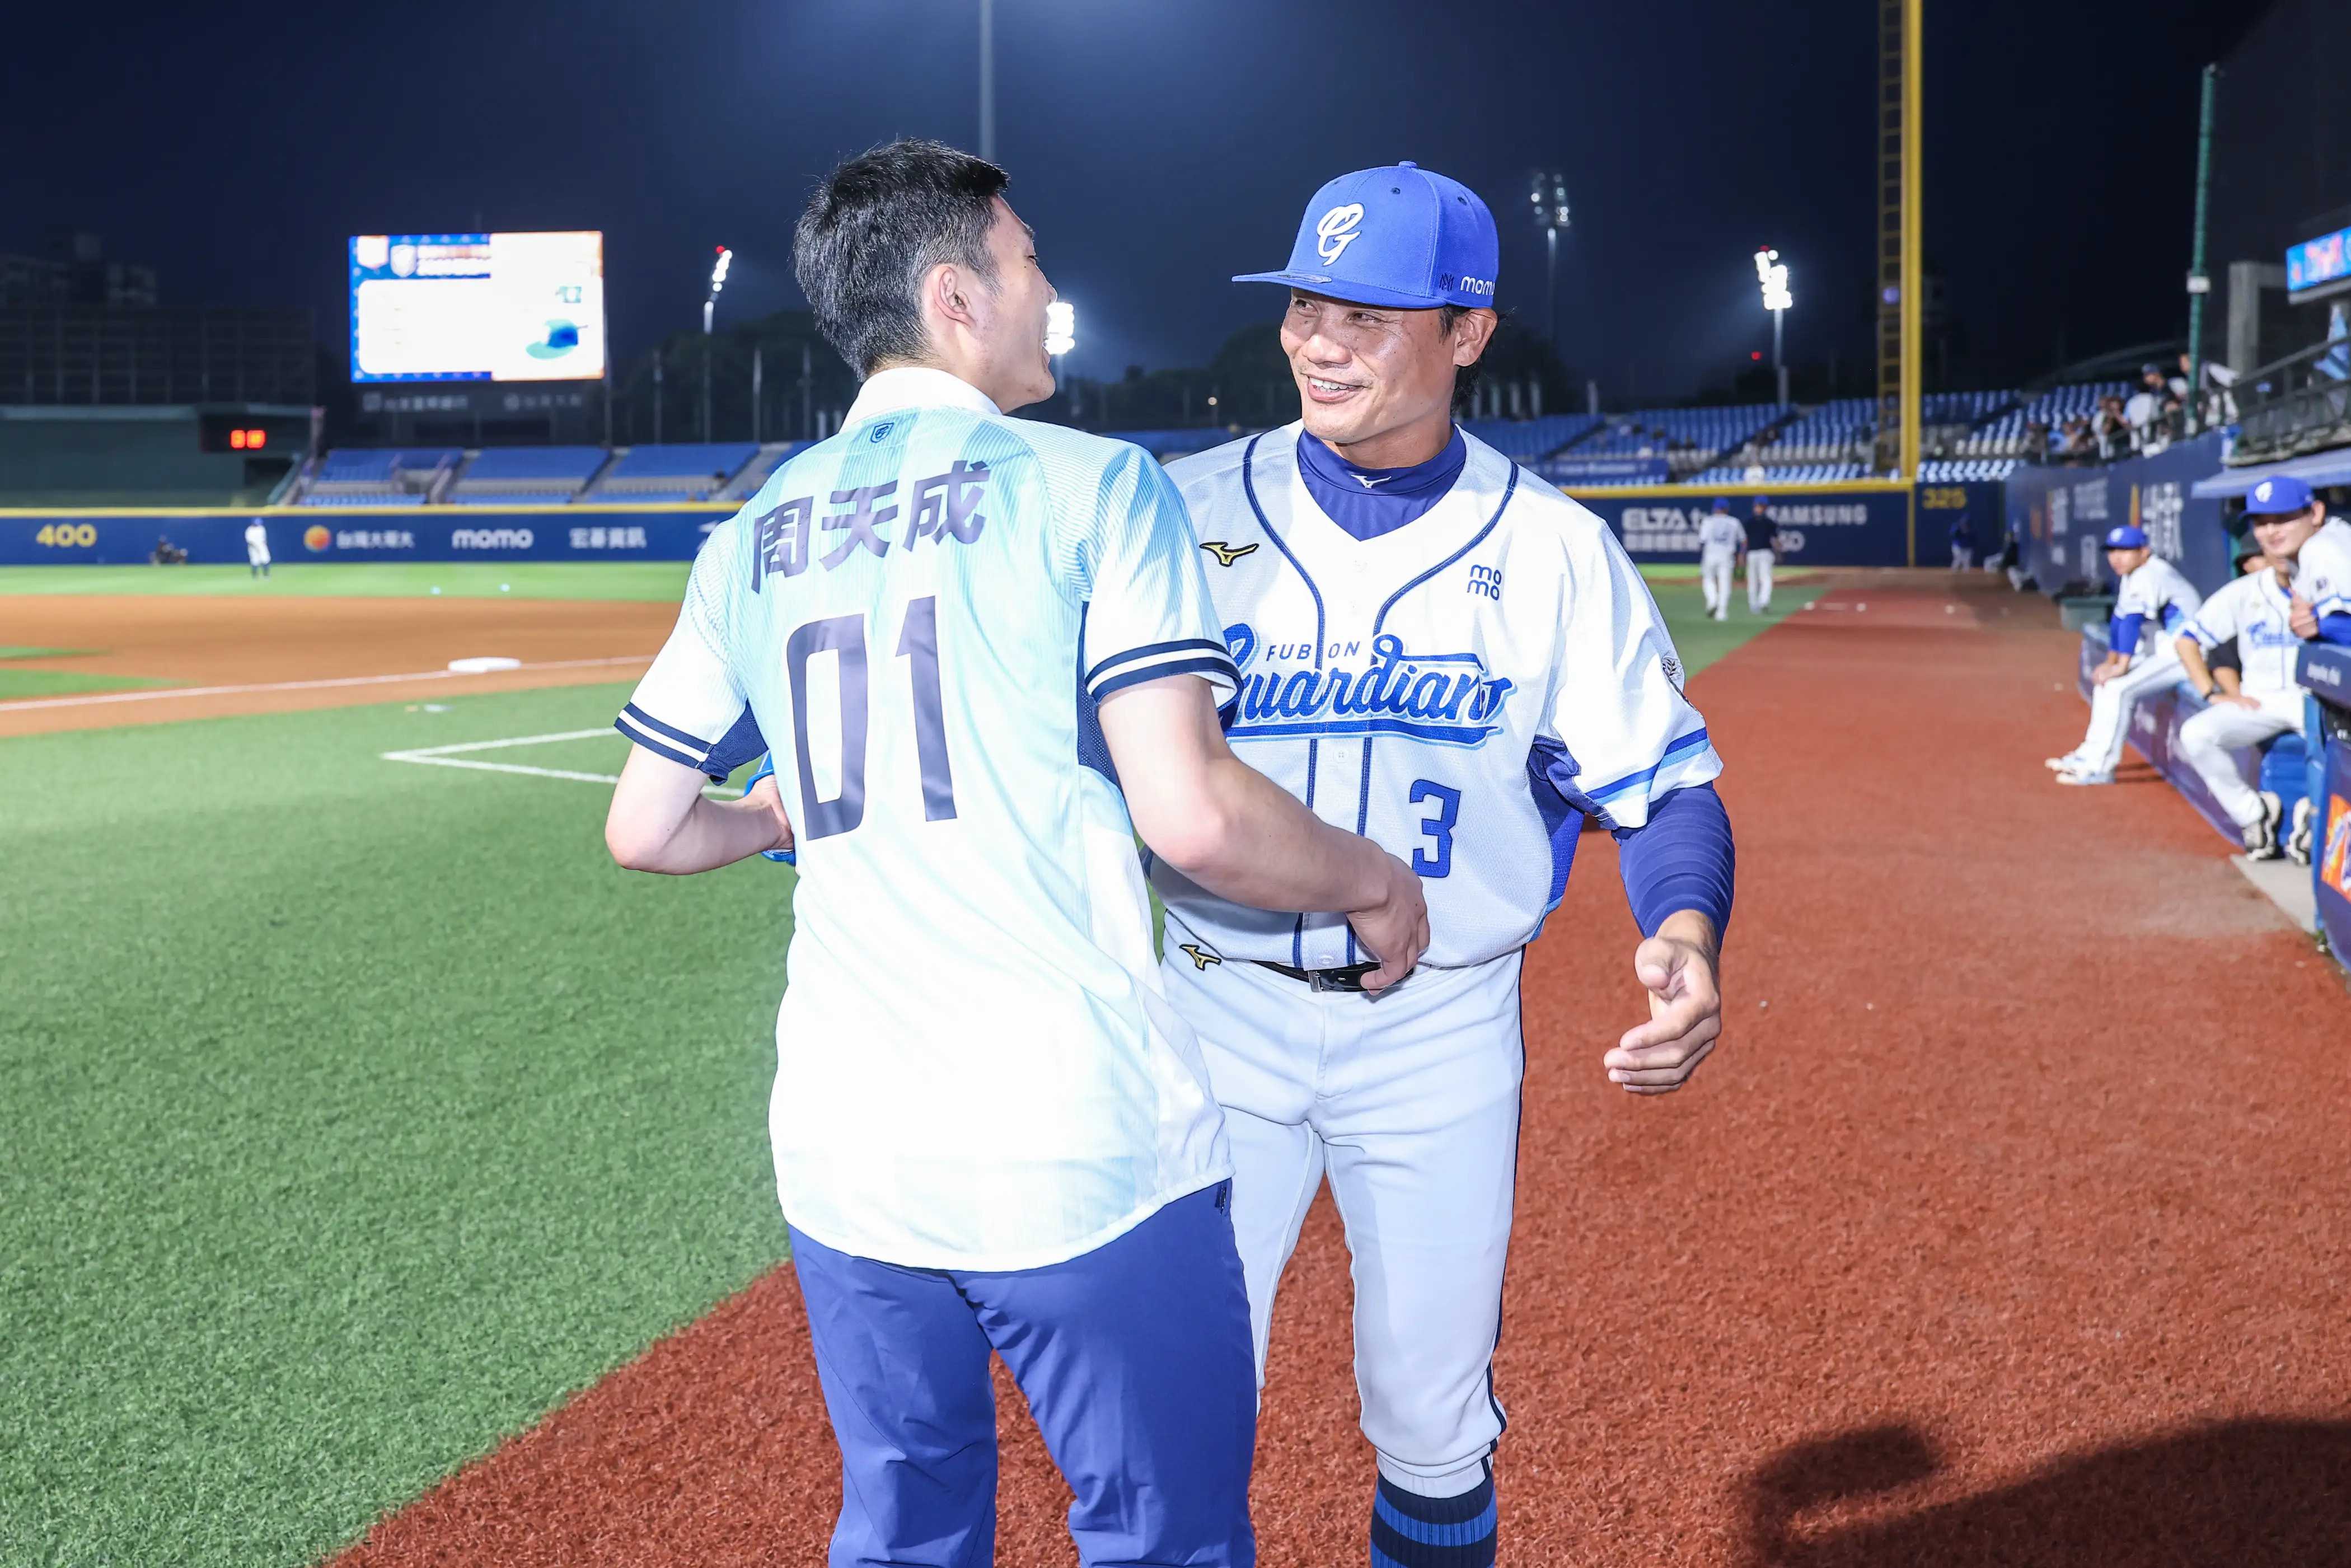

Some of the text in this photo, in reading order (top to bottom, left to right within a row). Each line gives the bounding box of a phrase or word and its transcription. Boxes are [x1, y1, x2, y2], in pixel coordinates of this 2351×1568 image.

[36, 523, 97, 547] 400
[452, 528, 534, 549] momo
[751, 460, 991, 595] 周天成
[786, 595, 957, 841] 01
[1409, 779, 1462, 878] 3
